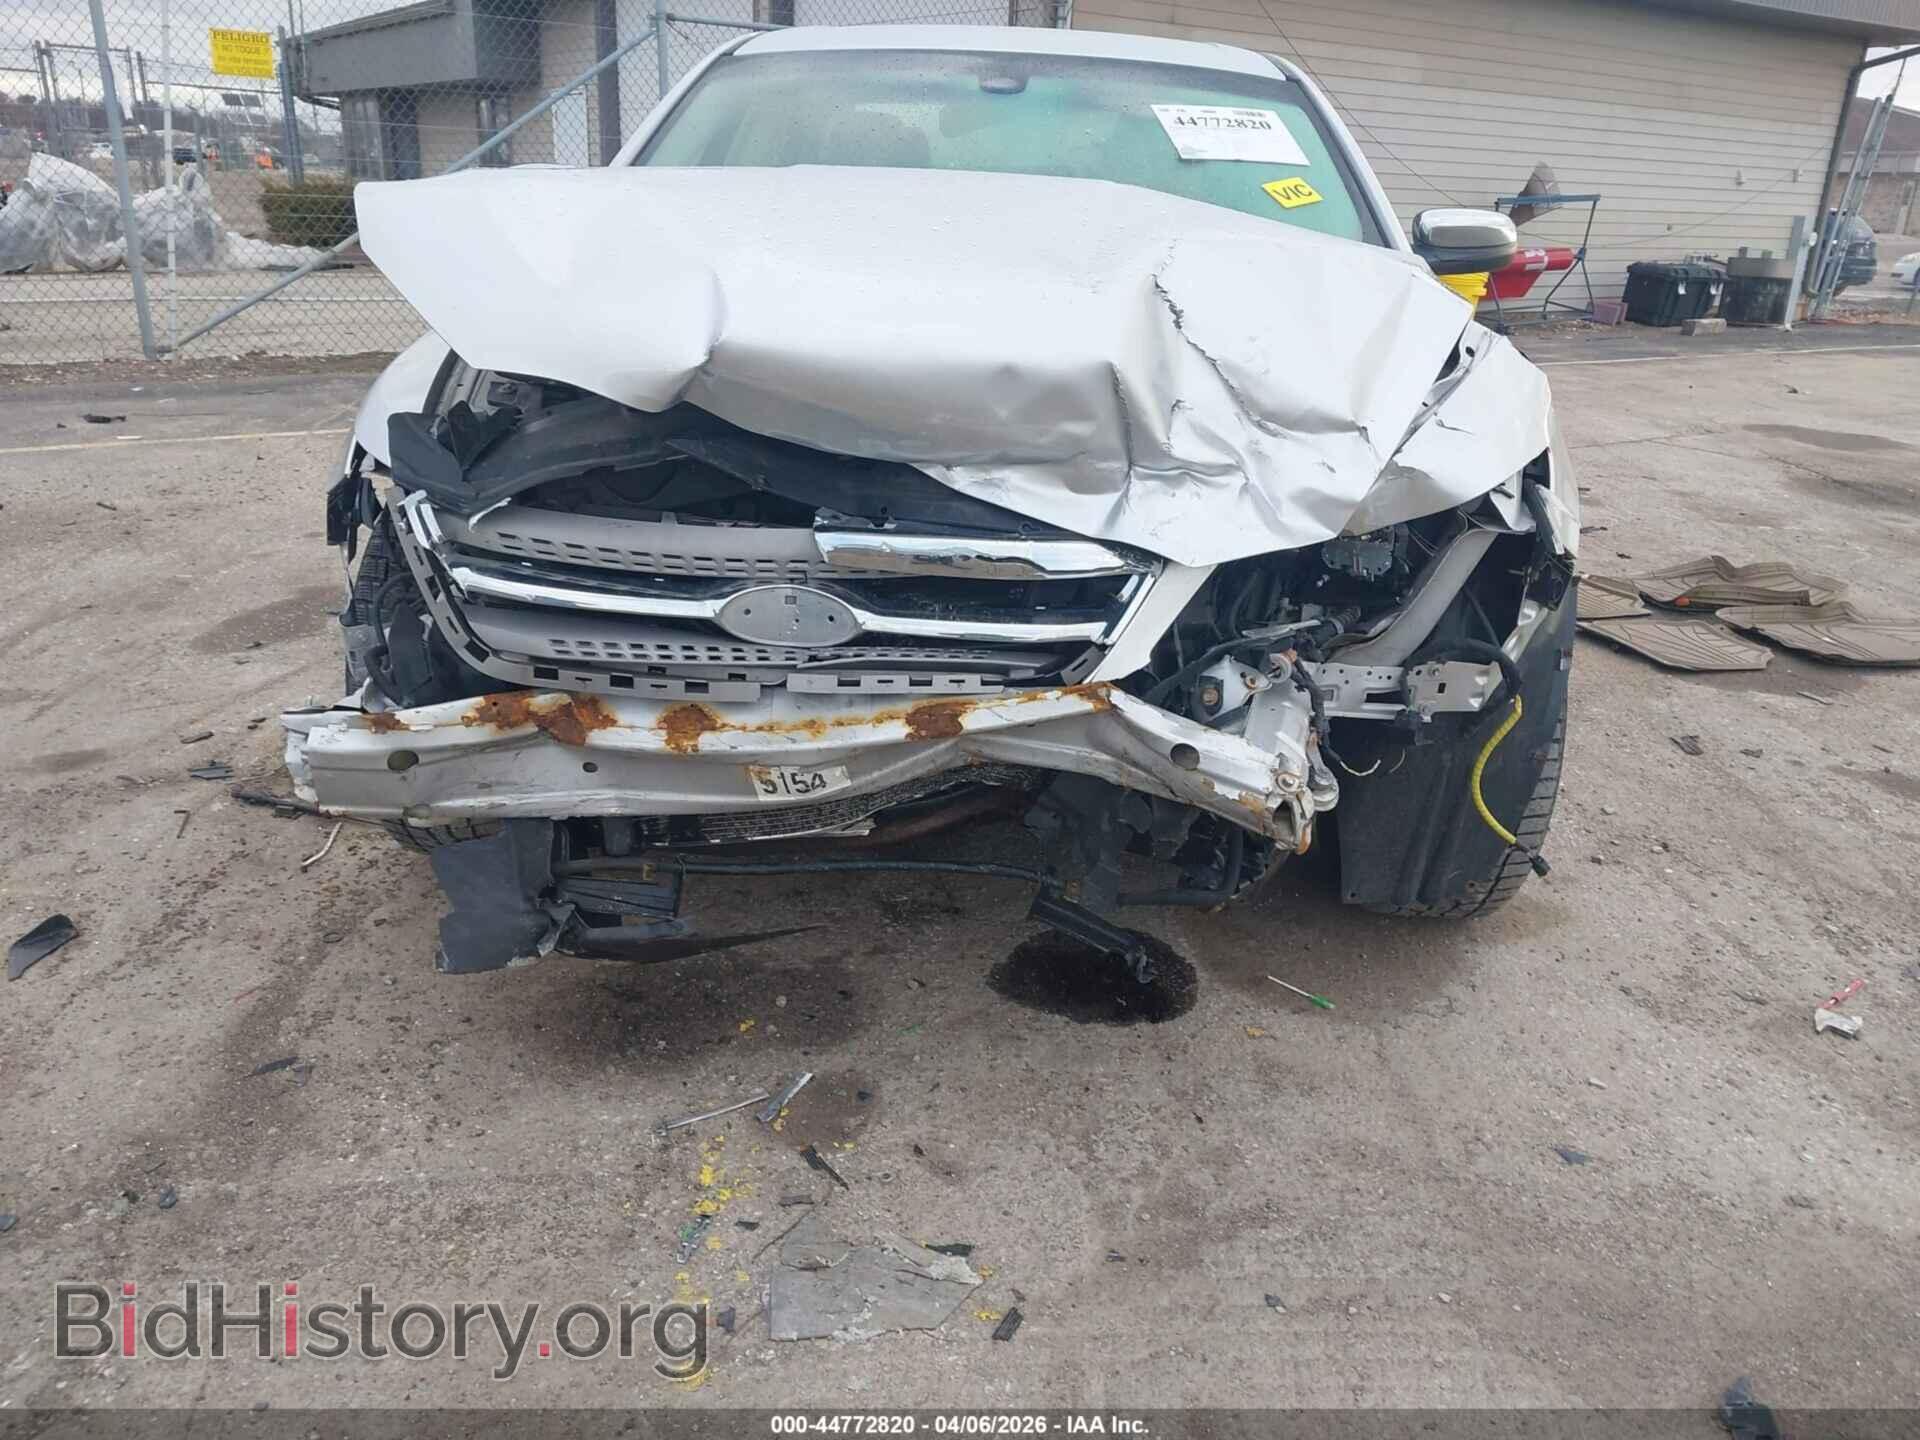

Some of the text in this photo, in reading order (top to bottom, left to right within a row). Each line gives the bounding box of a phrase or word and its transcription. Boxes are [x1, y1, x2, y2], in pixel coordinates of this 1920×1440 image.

[213, 31, 269, 43] PELIGRO
[235, 45, 260, 55] TOQUE
[1174, 116, 1272, 130] 44772820
[1272, 184, 1312, 200] VIC
